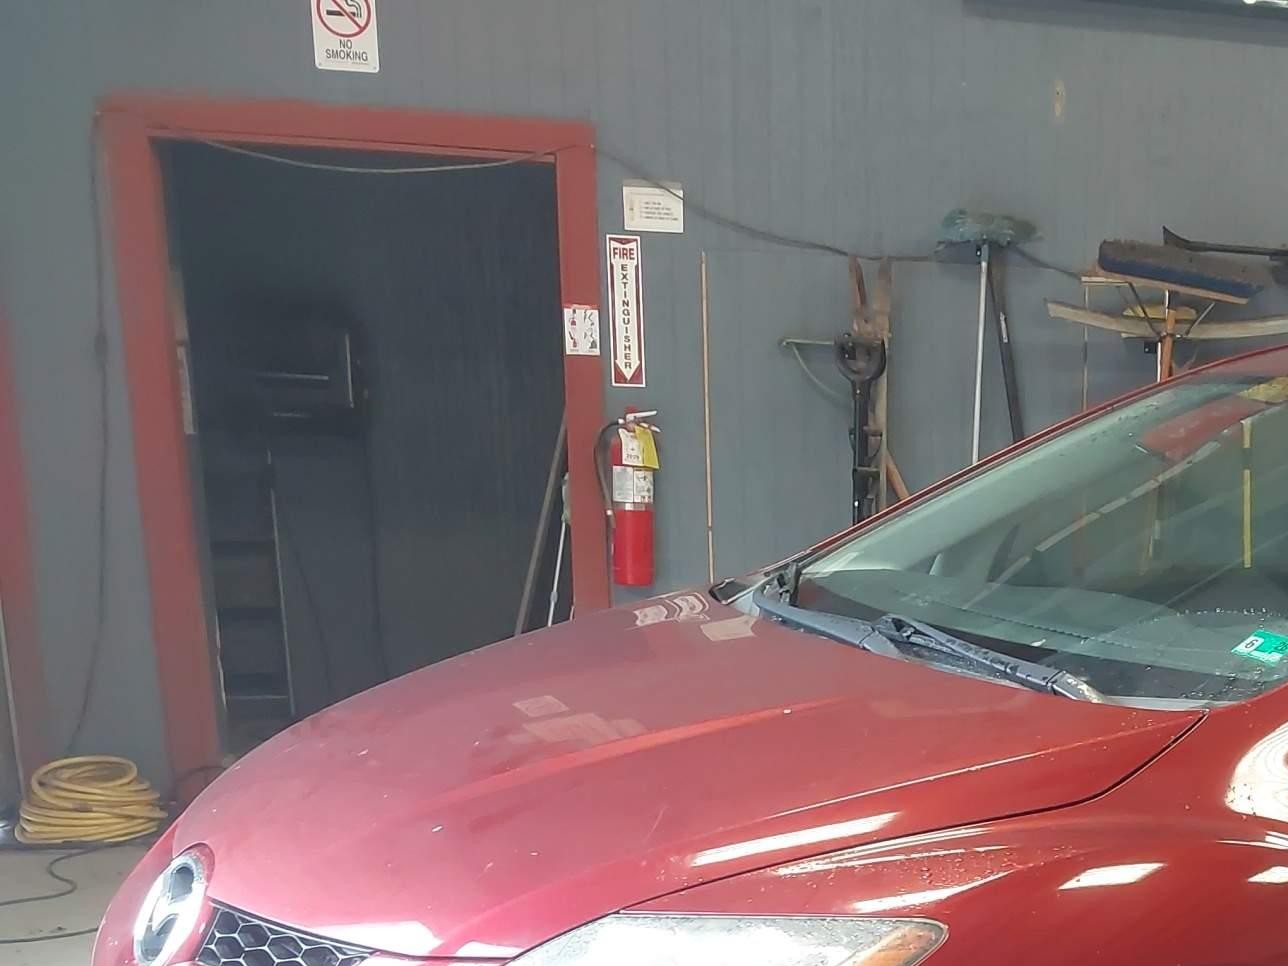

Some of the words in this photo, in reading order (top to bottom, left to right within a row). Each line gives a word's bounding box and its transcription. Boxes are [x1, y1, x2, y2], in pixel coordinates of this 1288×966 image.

[339, 39, 353, 50] NO
[325, 48, 368, 62] SMOKING
[612, 247, 636, 261] FIRE
[620, 264, 632, 370] EXTINGUISHER
